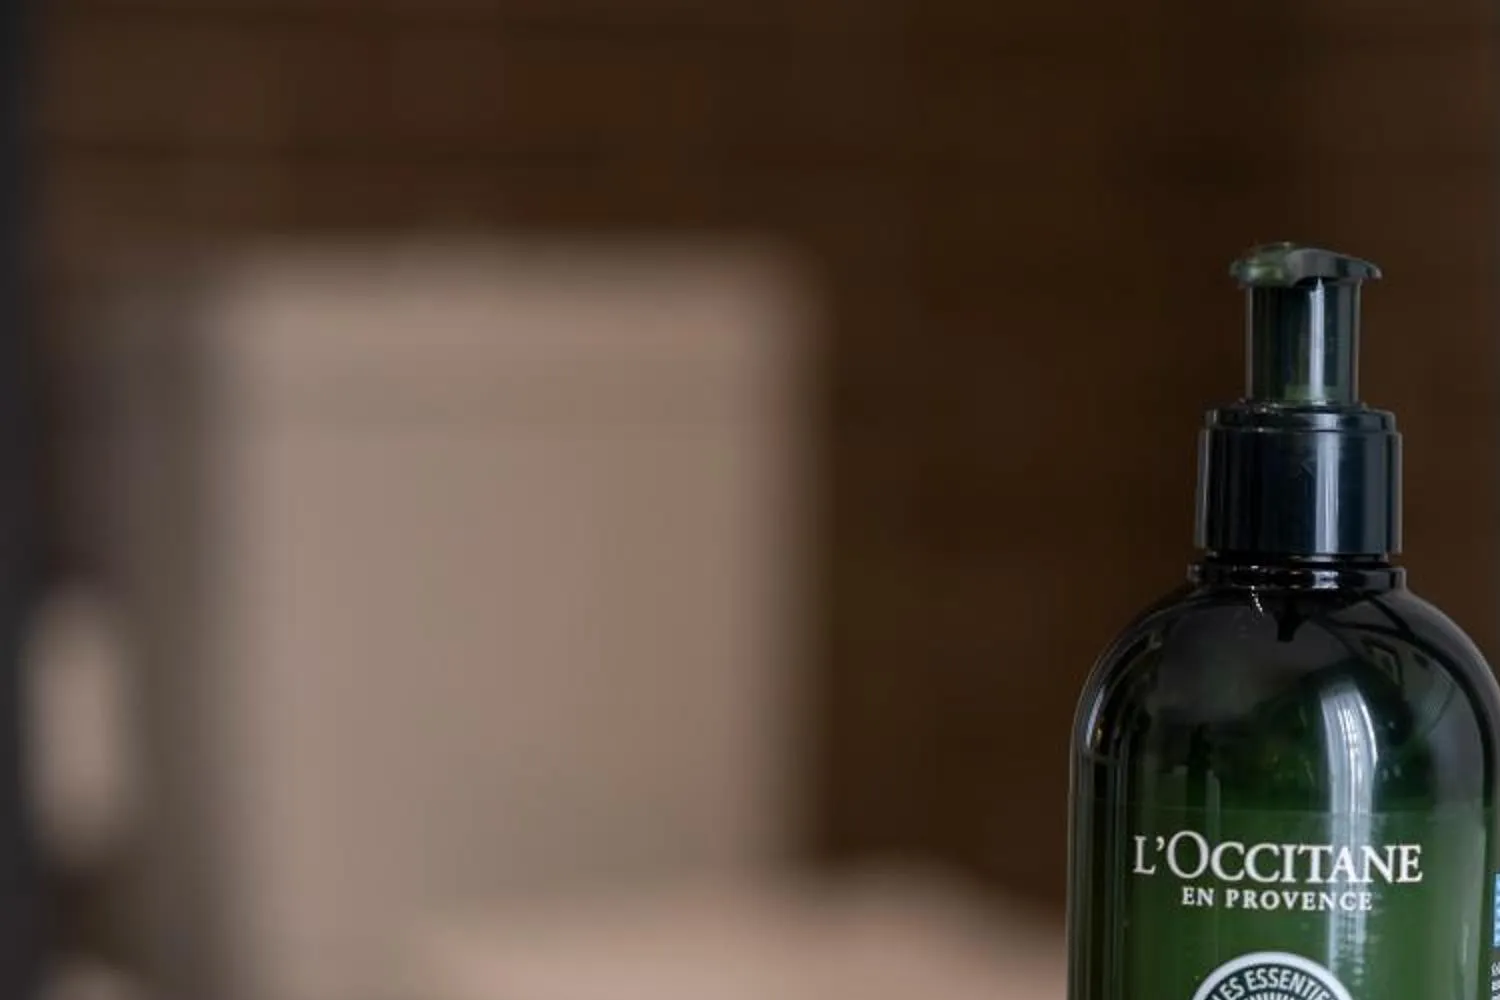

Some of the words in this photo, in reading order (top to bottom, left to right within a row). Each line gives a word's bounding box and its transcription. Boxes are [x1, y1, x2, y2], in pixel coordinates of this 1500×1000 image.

[1132, 829, 1423, 884] L'OCCITANE
[1183, 886, 1214, 907] EN
[1226, 889, 1374, 912] PROVENCE
